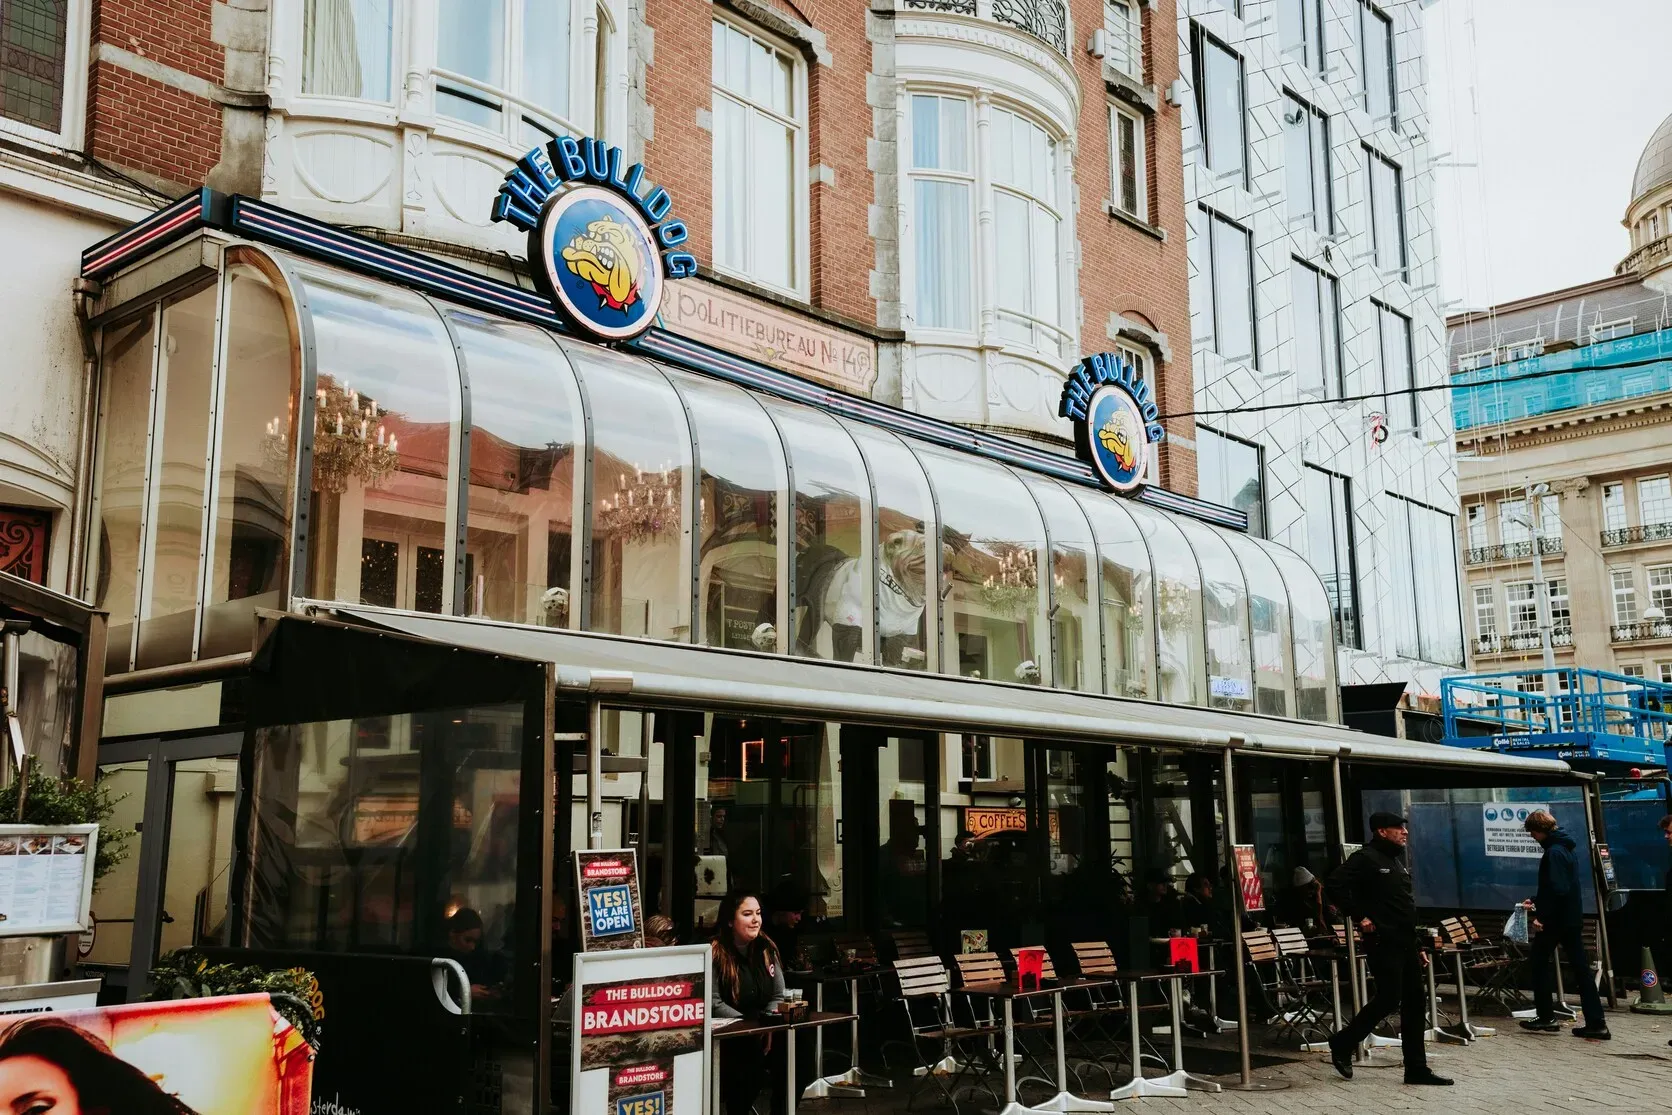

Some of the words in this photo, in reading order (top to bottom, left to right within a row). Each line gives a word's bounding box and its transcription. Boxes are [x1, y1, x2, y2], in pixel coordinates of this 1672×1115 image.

[491, 147, 563, 232] THE
[547, 136, 697, 279] BULLDOG
[1059, 364, 1096, 421] THE
[1081, 352, 1164, 443] BULLDOG
[587, 867, 627, 877] BRANDSTORE
[593, 891, 628, 909] YES!
[594, 908, 609, 918] WE
[610, 905, 629, 916] ARE
[595, 915, 630, 931] OPEN
[605, 988, 628, 1001] THE
[584, 1002, 704, 1030] BRANDSTORE
[618, 1072, 664, 1084] BRANDSTORE
[621, 1098, 661, 1115] YES!
